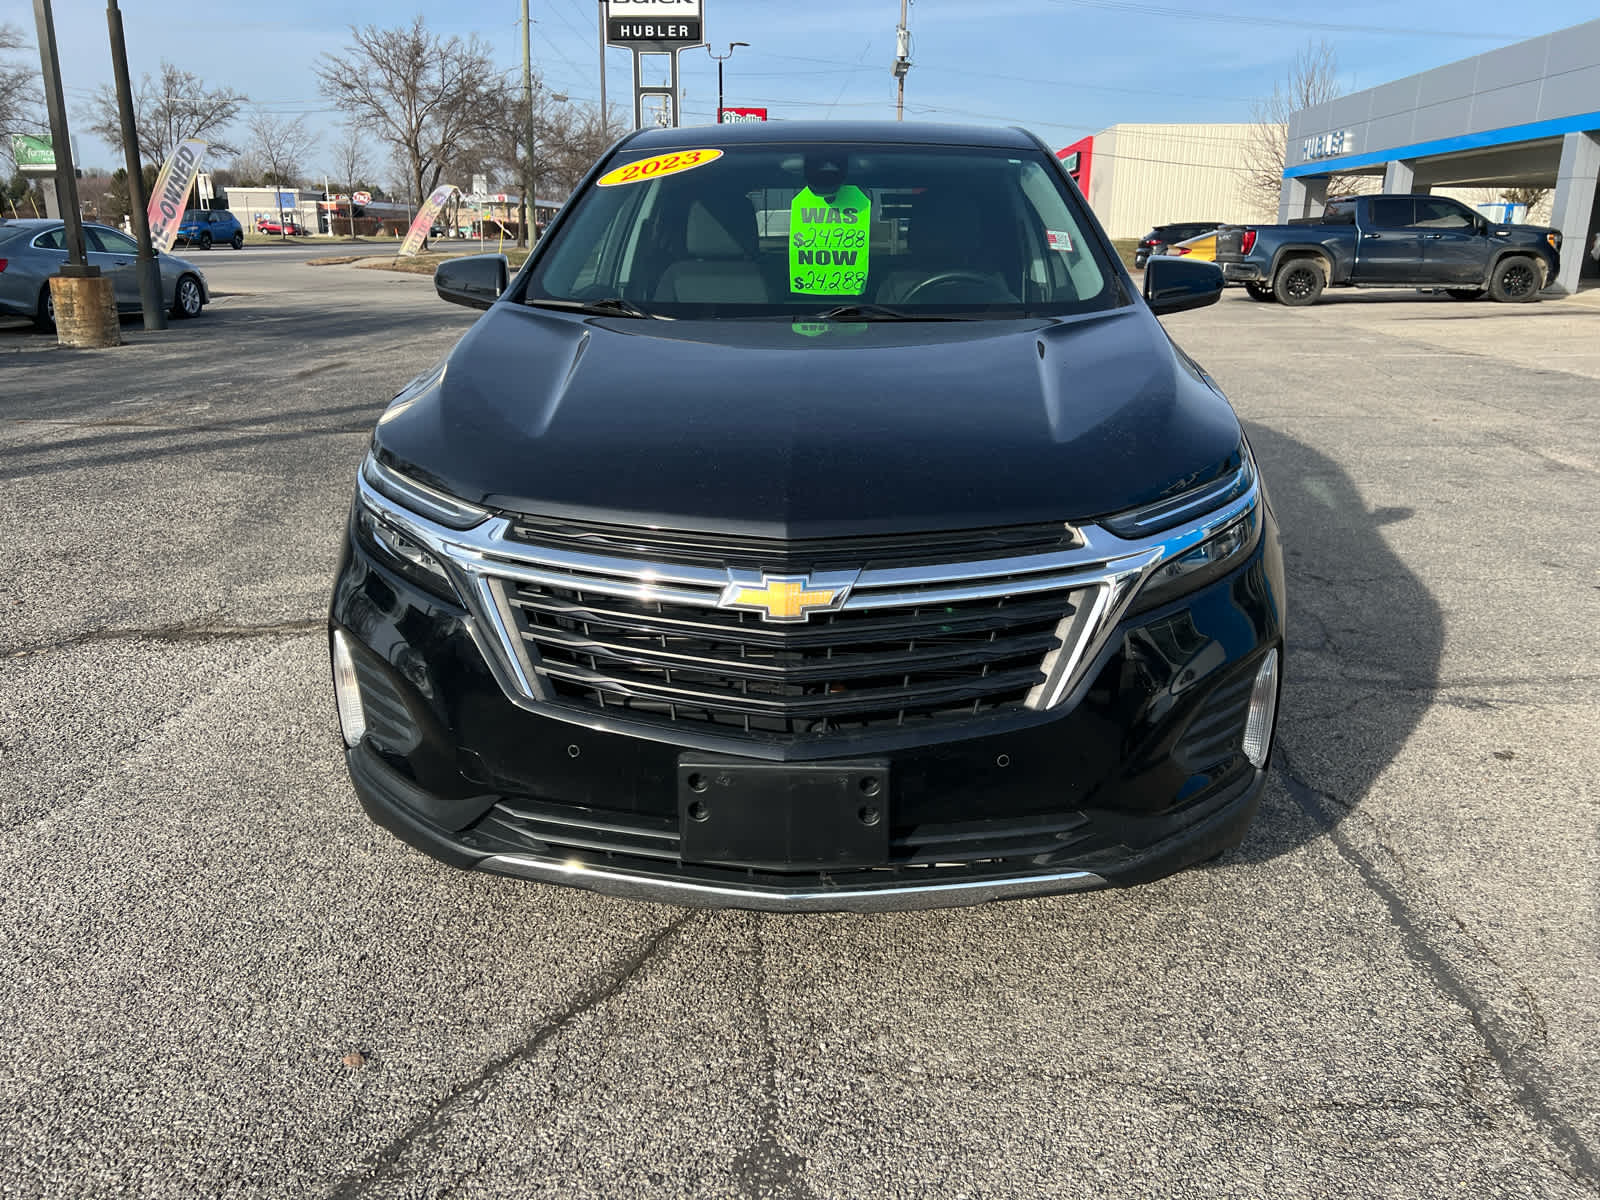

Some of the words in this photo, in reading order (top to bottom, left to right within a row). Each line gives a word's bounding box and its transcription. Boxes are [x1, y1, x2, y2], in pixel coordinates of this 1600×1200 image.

[620, 24, 689, 37] HUBLER
[621, 151, 702, 182] 2023
[801, 207, 859, 225] WAS
[798, 250, 859, 266] NOW
